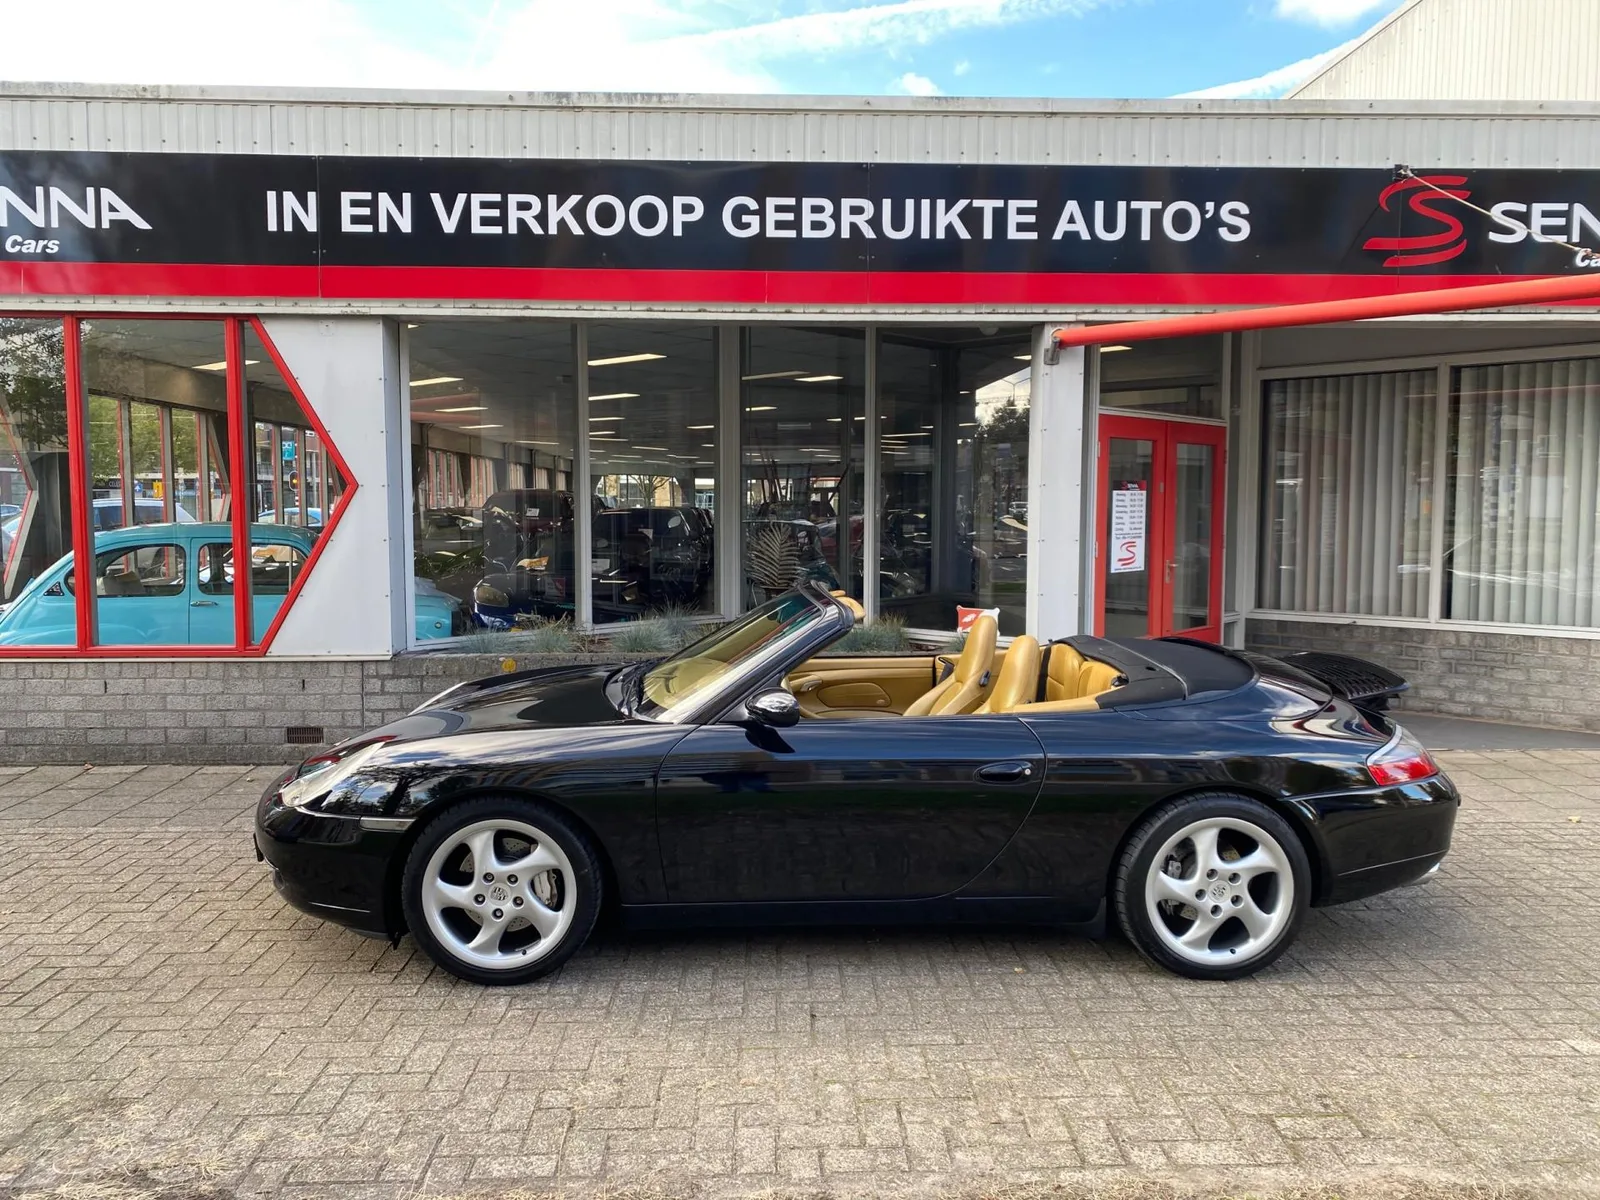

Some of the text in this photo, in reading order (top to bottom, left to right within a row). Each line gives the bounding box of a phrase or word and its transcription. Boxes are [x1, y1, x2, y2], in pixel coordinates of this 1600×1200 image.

[266, 190, 1251, 243] IN EN VERKOOP GEBRUIKTE AUTO'S
[4, 234, 61, 254] Cars
